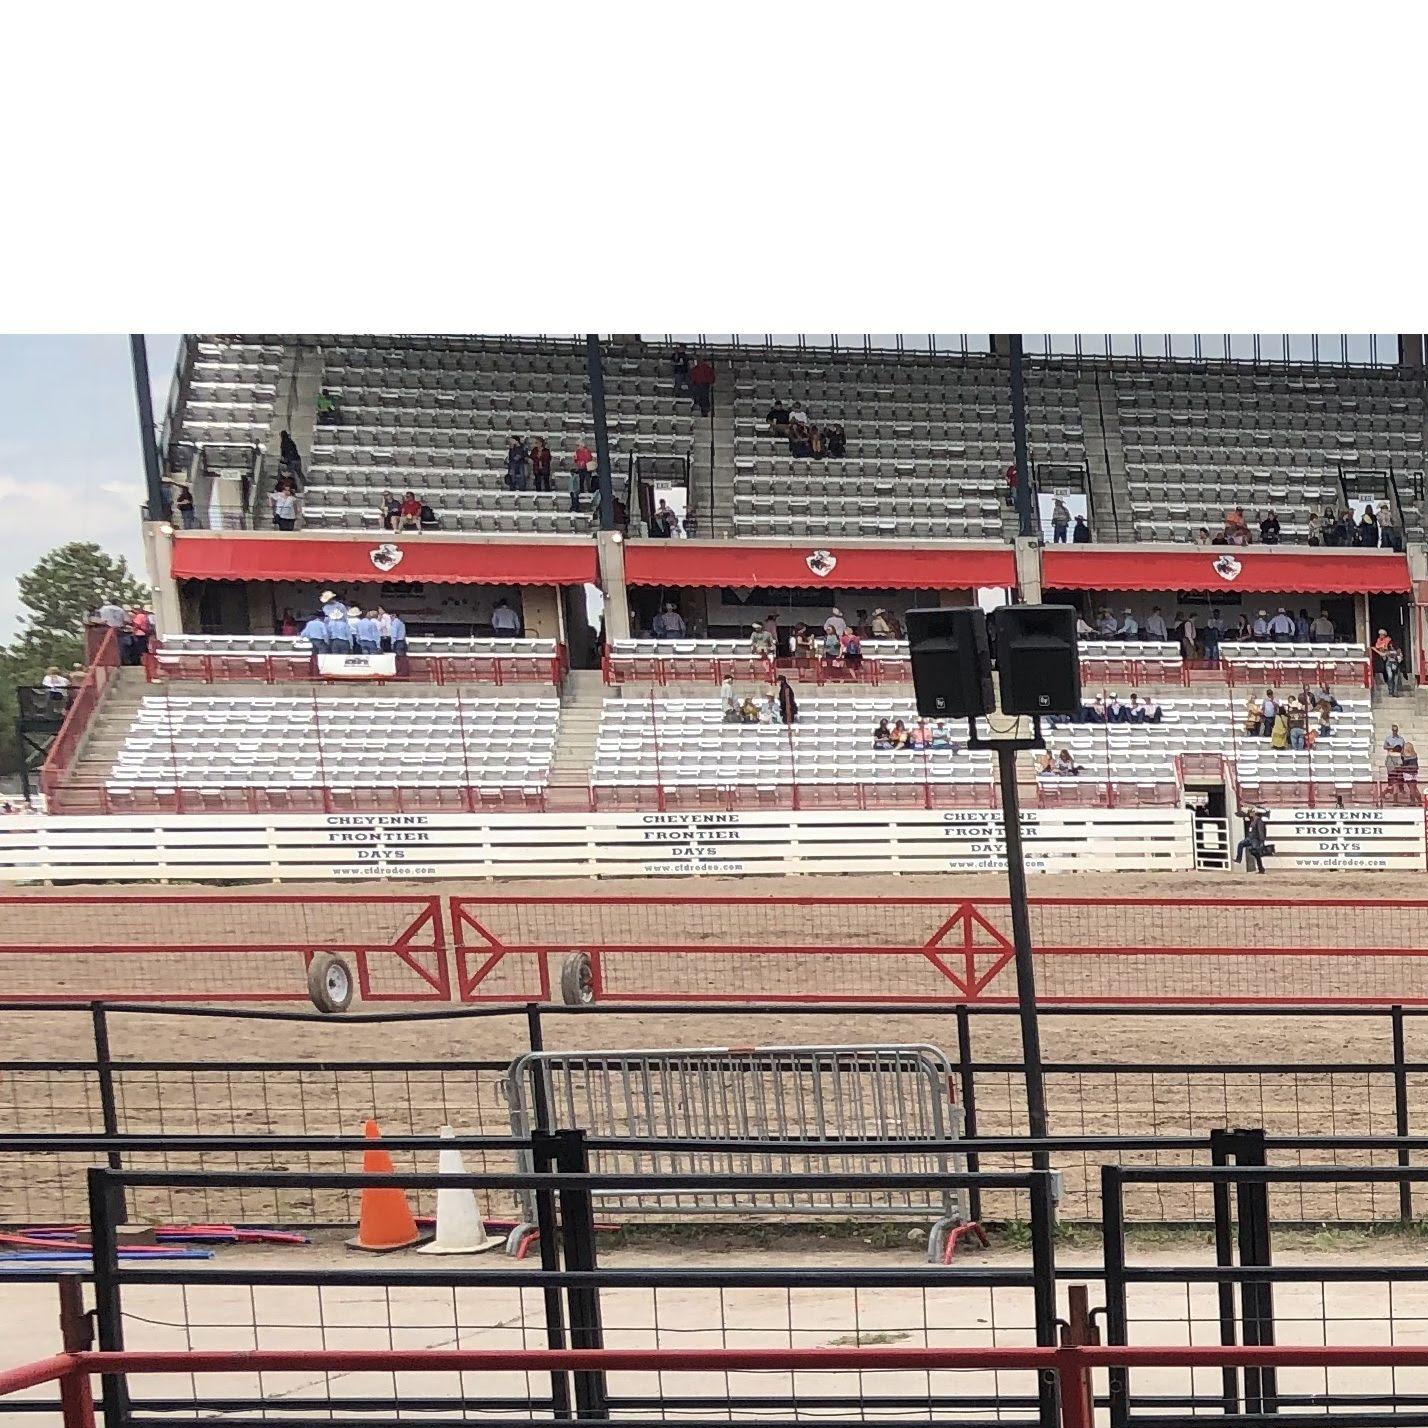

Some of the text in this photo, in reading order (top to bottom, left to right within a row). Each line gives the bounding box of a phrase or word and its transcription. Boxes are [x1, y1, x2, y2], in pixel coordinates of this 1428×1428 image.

[327, 816, 428, 824] CHEYENNE
[643, 815, 739, 823] CHEYENNE
[644, 831, 740, 839] FRONTIER
